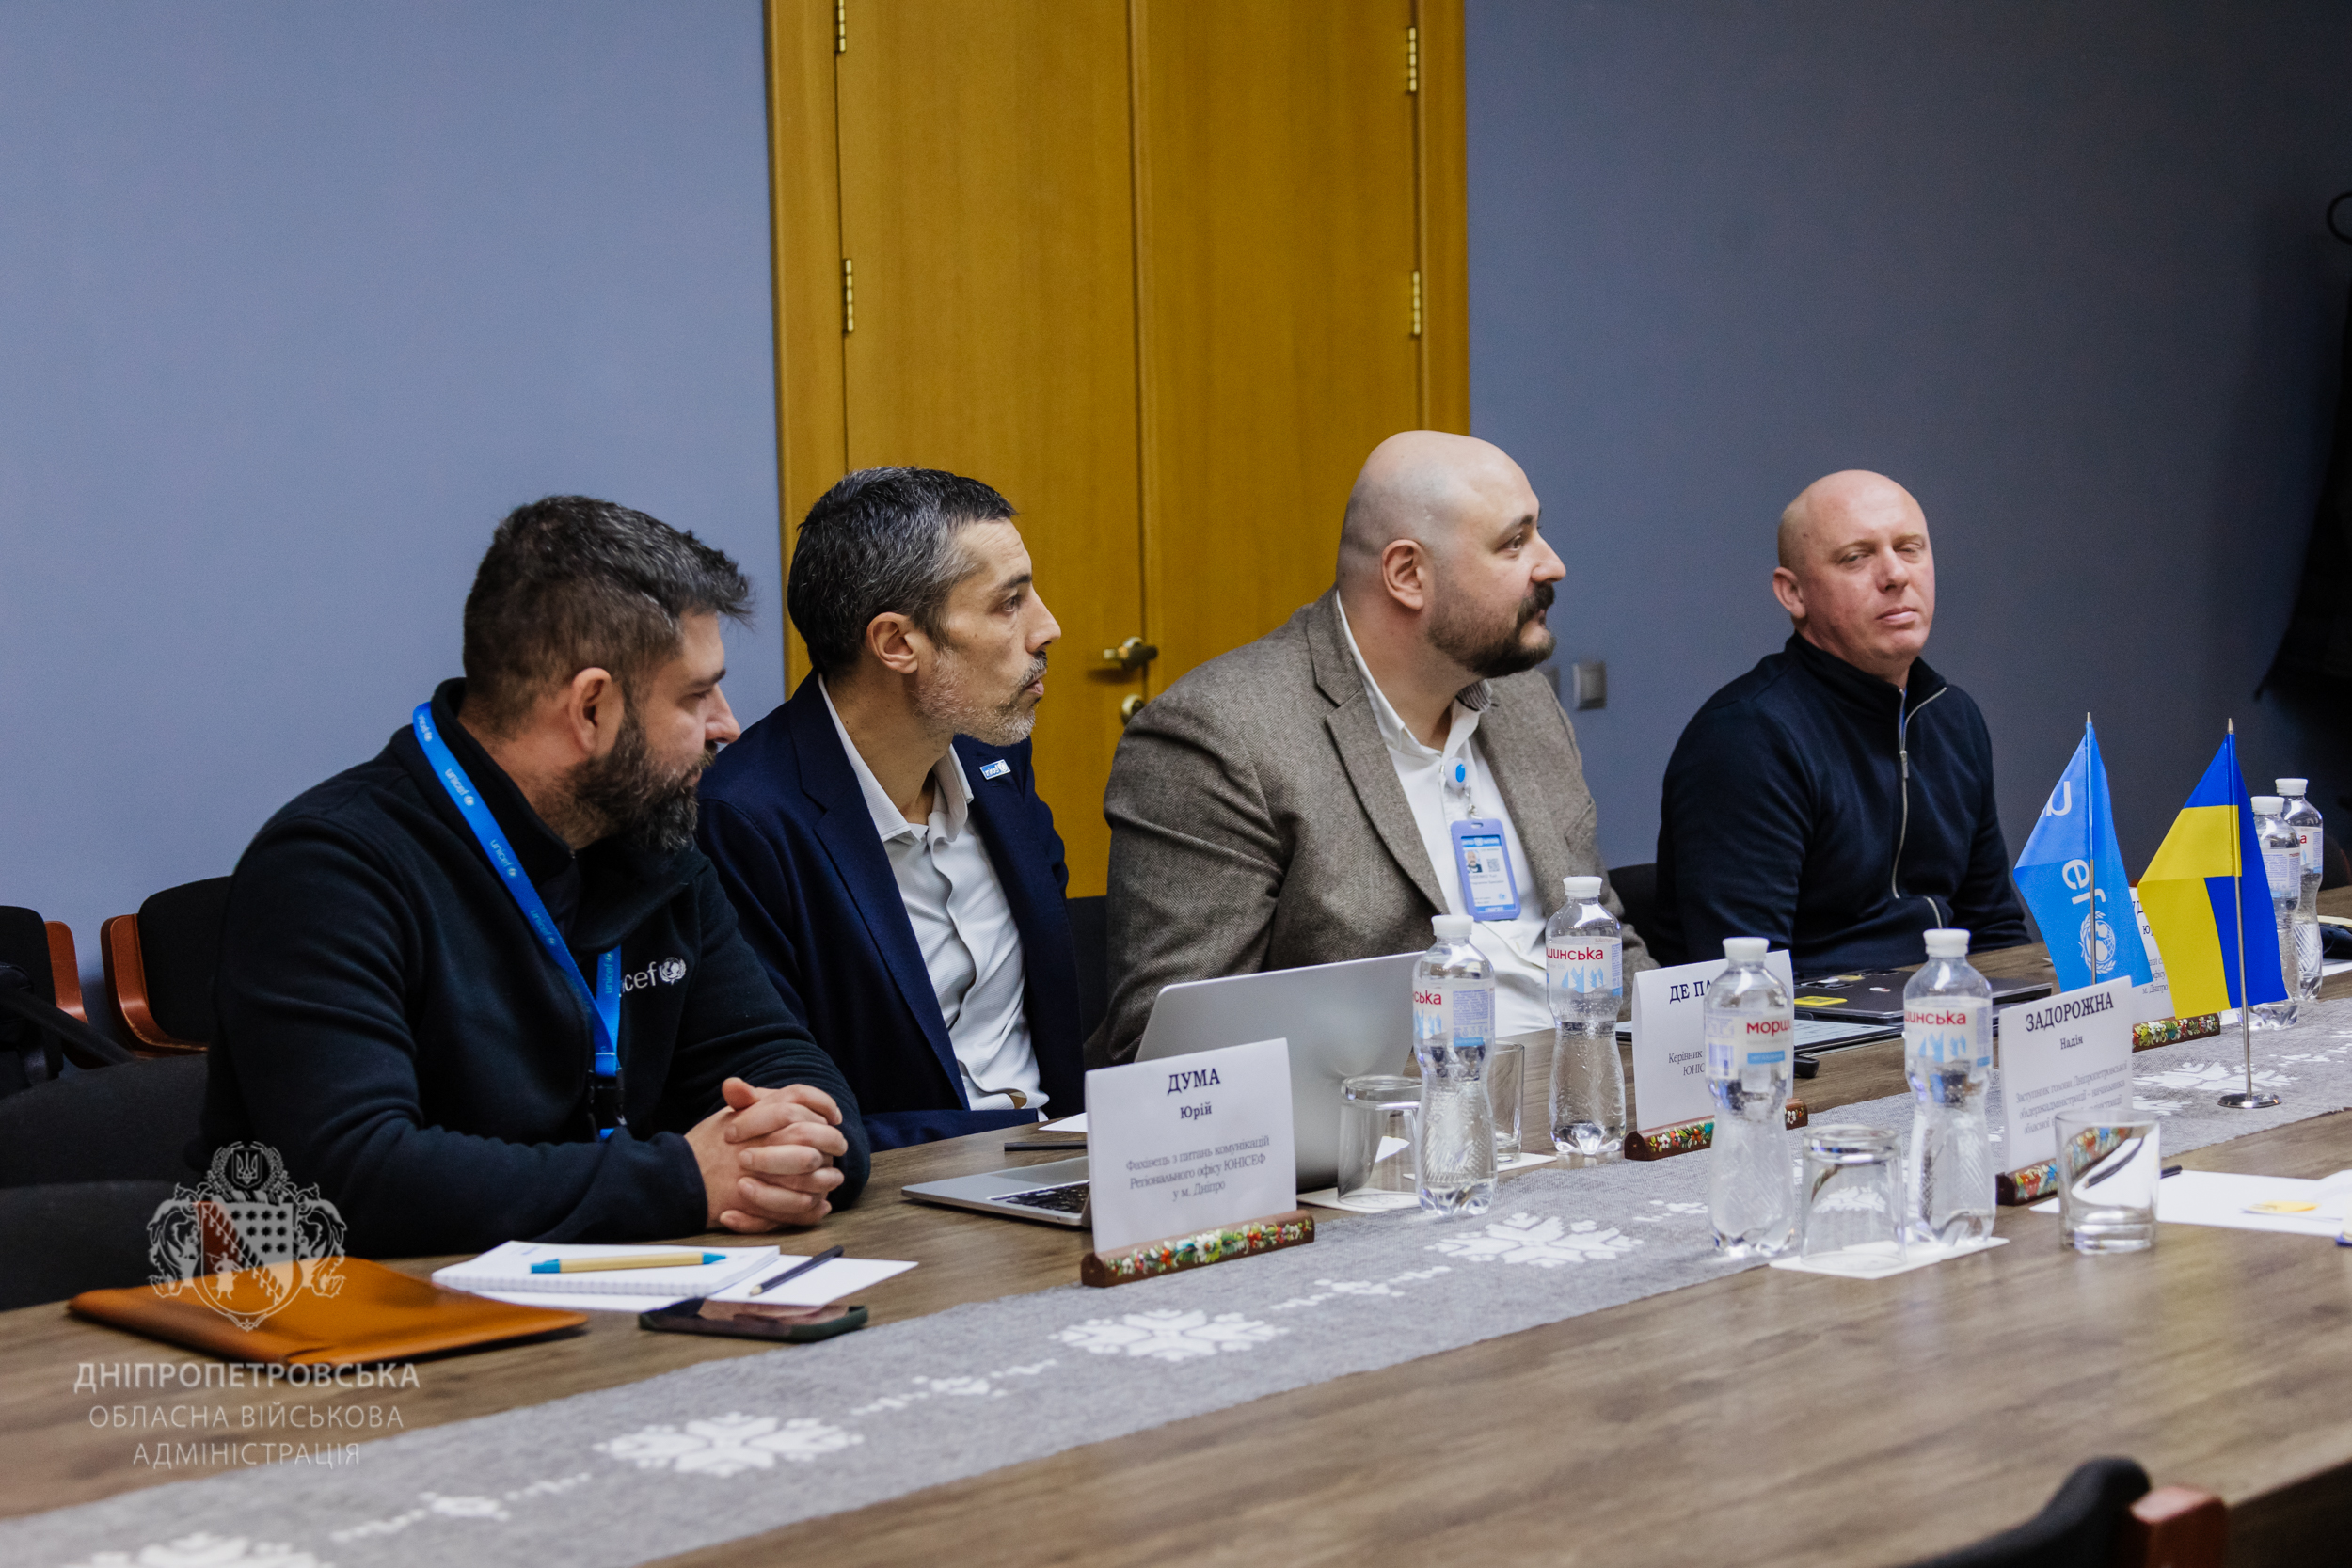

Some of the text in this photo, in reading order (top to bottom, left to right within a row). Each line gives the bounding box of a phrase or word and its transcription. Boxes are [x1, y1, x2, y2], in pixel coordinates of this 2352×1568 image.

[489, 839, 514, 869] unicef
[1669, 983, 1691, 1005] ДЕ
[2149, 983, 2169, 994] Дніпро
[2026, 991, 2114, 1032] ЗАДОРОЖНА
[1746, 1019, 1790, 1037] морш
[2060, 1035, 2084, 1051] Надія
[1668, 1051, 1703, 1065] Керівник
[1167, 1068, 1221, 1095] ДУМА
[1180, 1101, 1213, 1120] Юрій
[1126, 1154, 1170, 1171] Фахівець
[1179, 1148, 1213, 1163] питань
[1215, 1134, 1270, 1156] комунікацій
[1130, 1153, 1266, 1189] Регіонального офісу ЮНІСЕФ
[1172, 1180, 1226, 1202] у м. Дніпро
